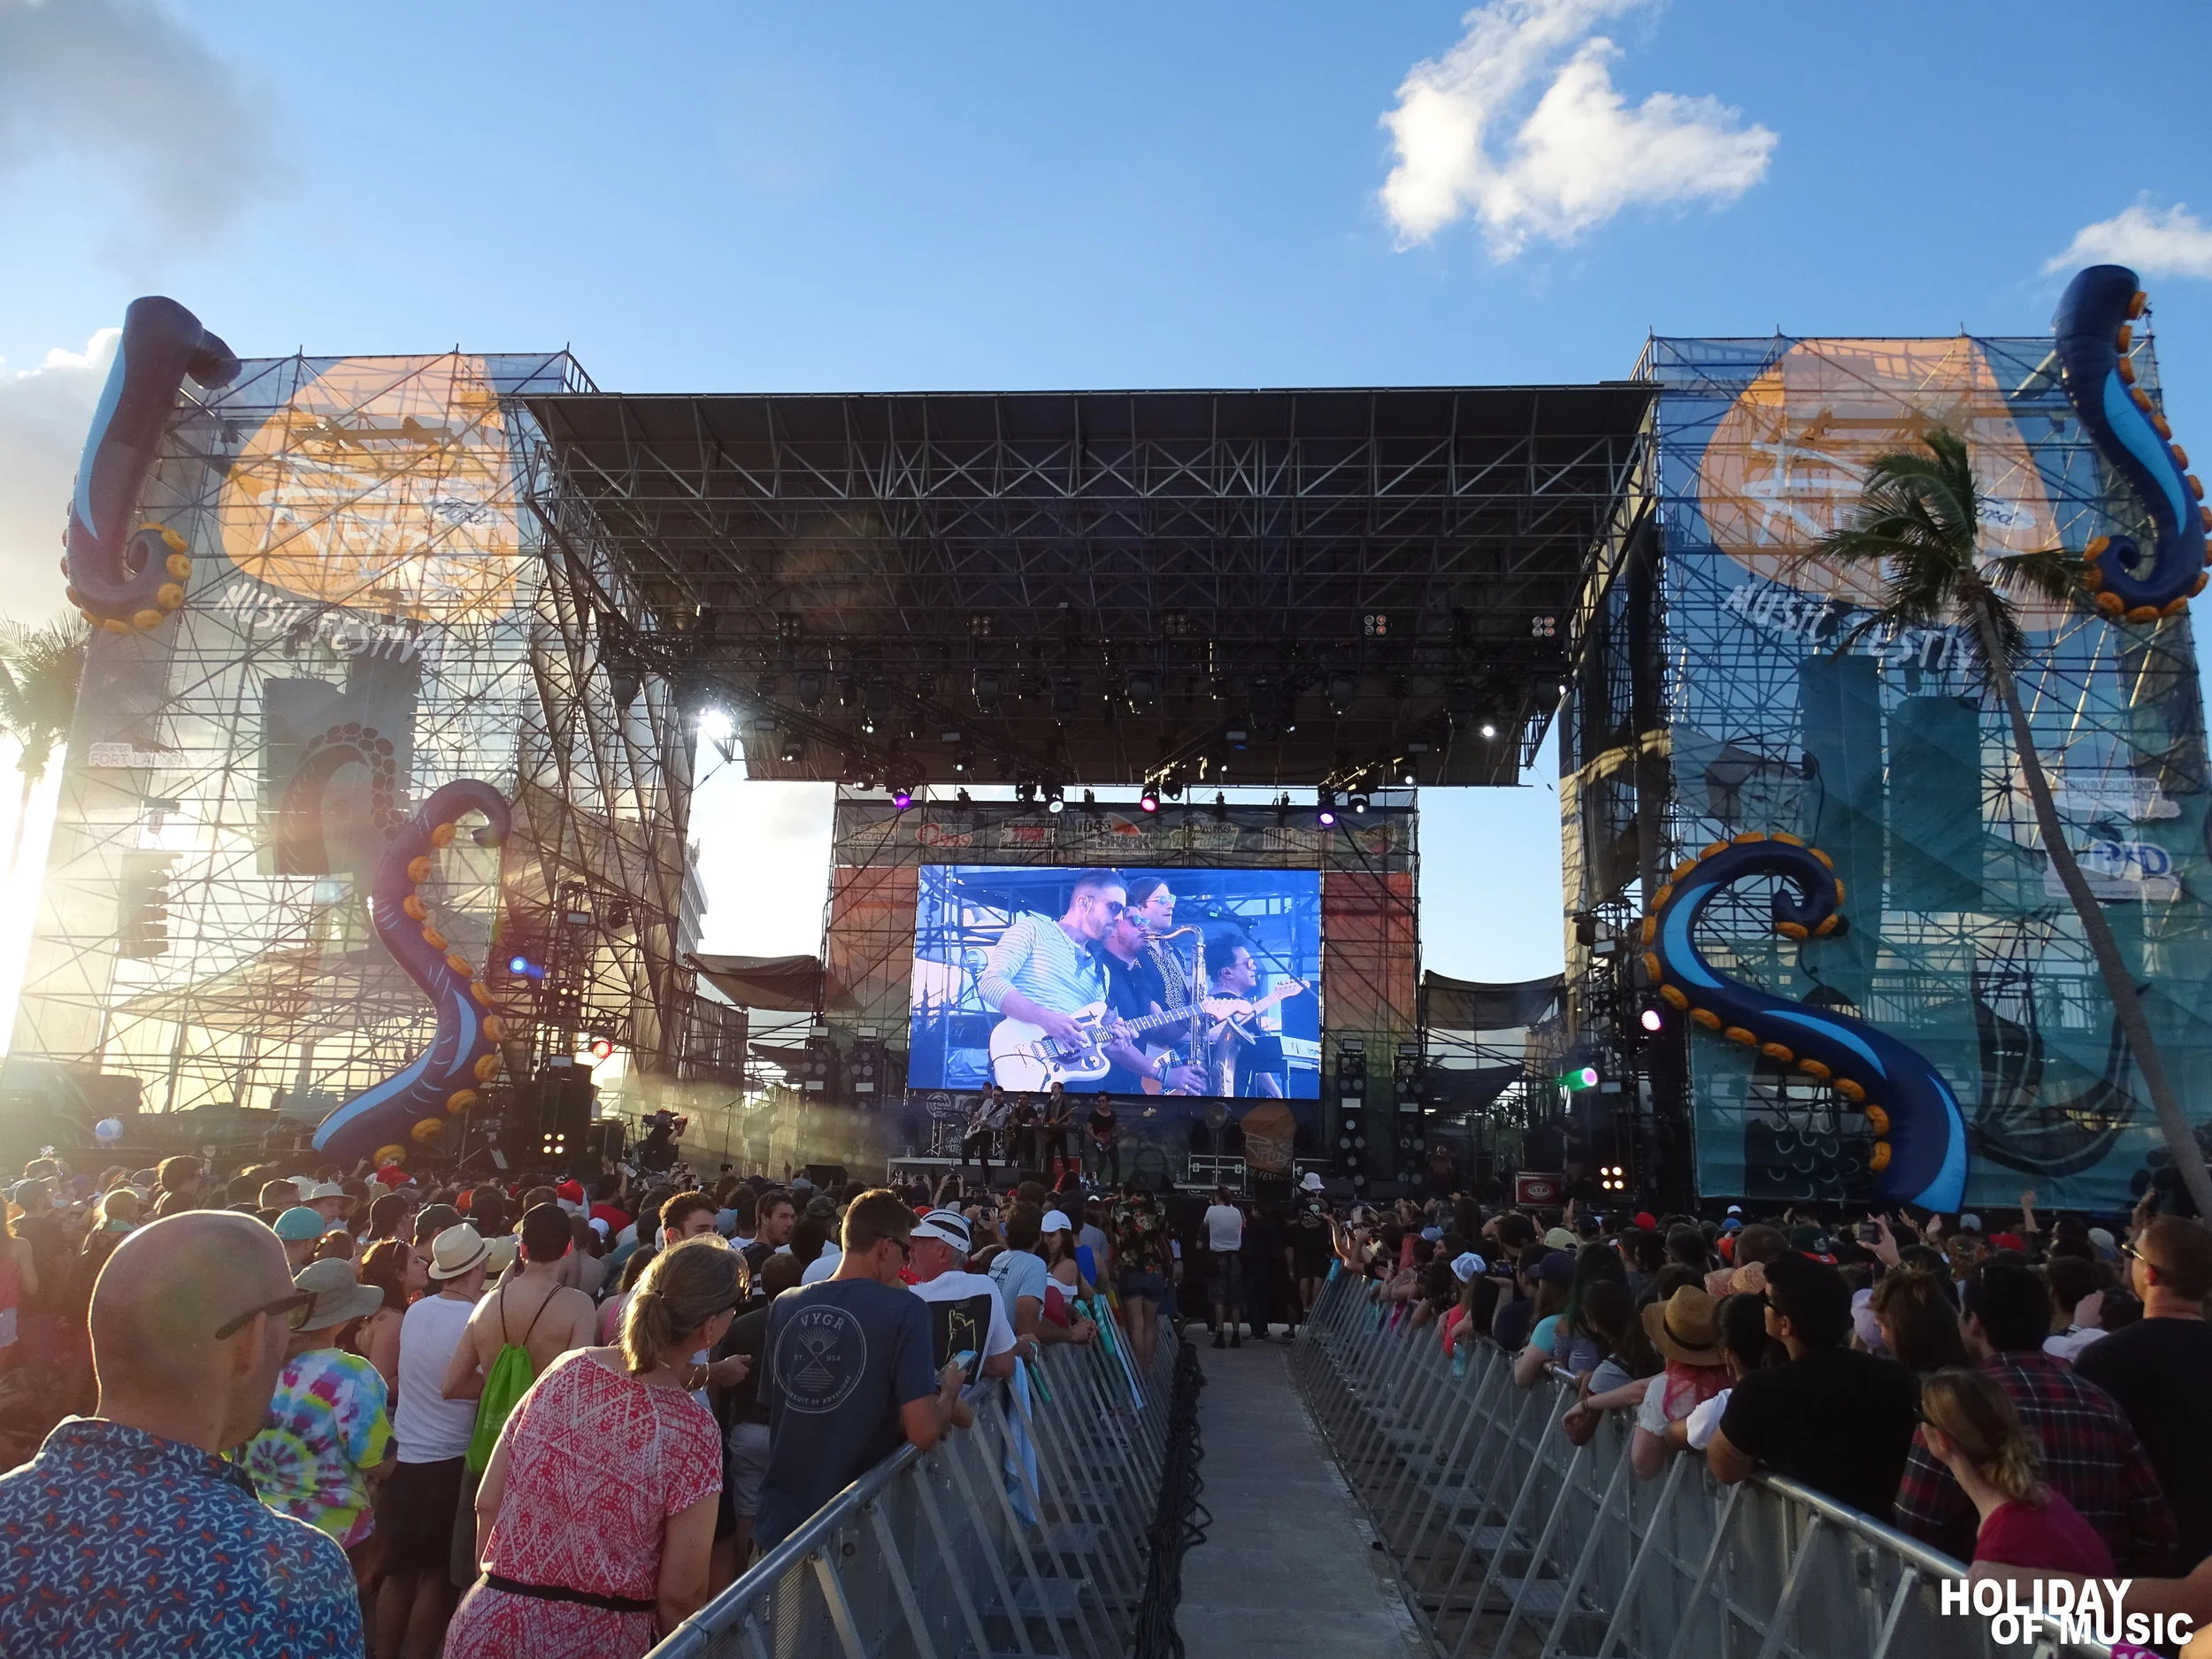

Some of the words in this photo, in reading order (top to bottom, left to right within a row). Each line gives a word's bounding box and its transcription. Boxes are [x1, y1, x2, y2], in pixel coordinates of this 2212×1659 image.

[1974, 492, 2020, 526] ord
[1721, 582, 1834, 644] MUSIC
[91, 754, 129, 765] FORT
[800, 1312, 845, 1331] VYGR
